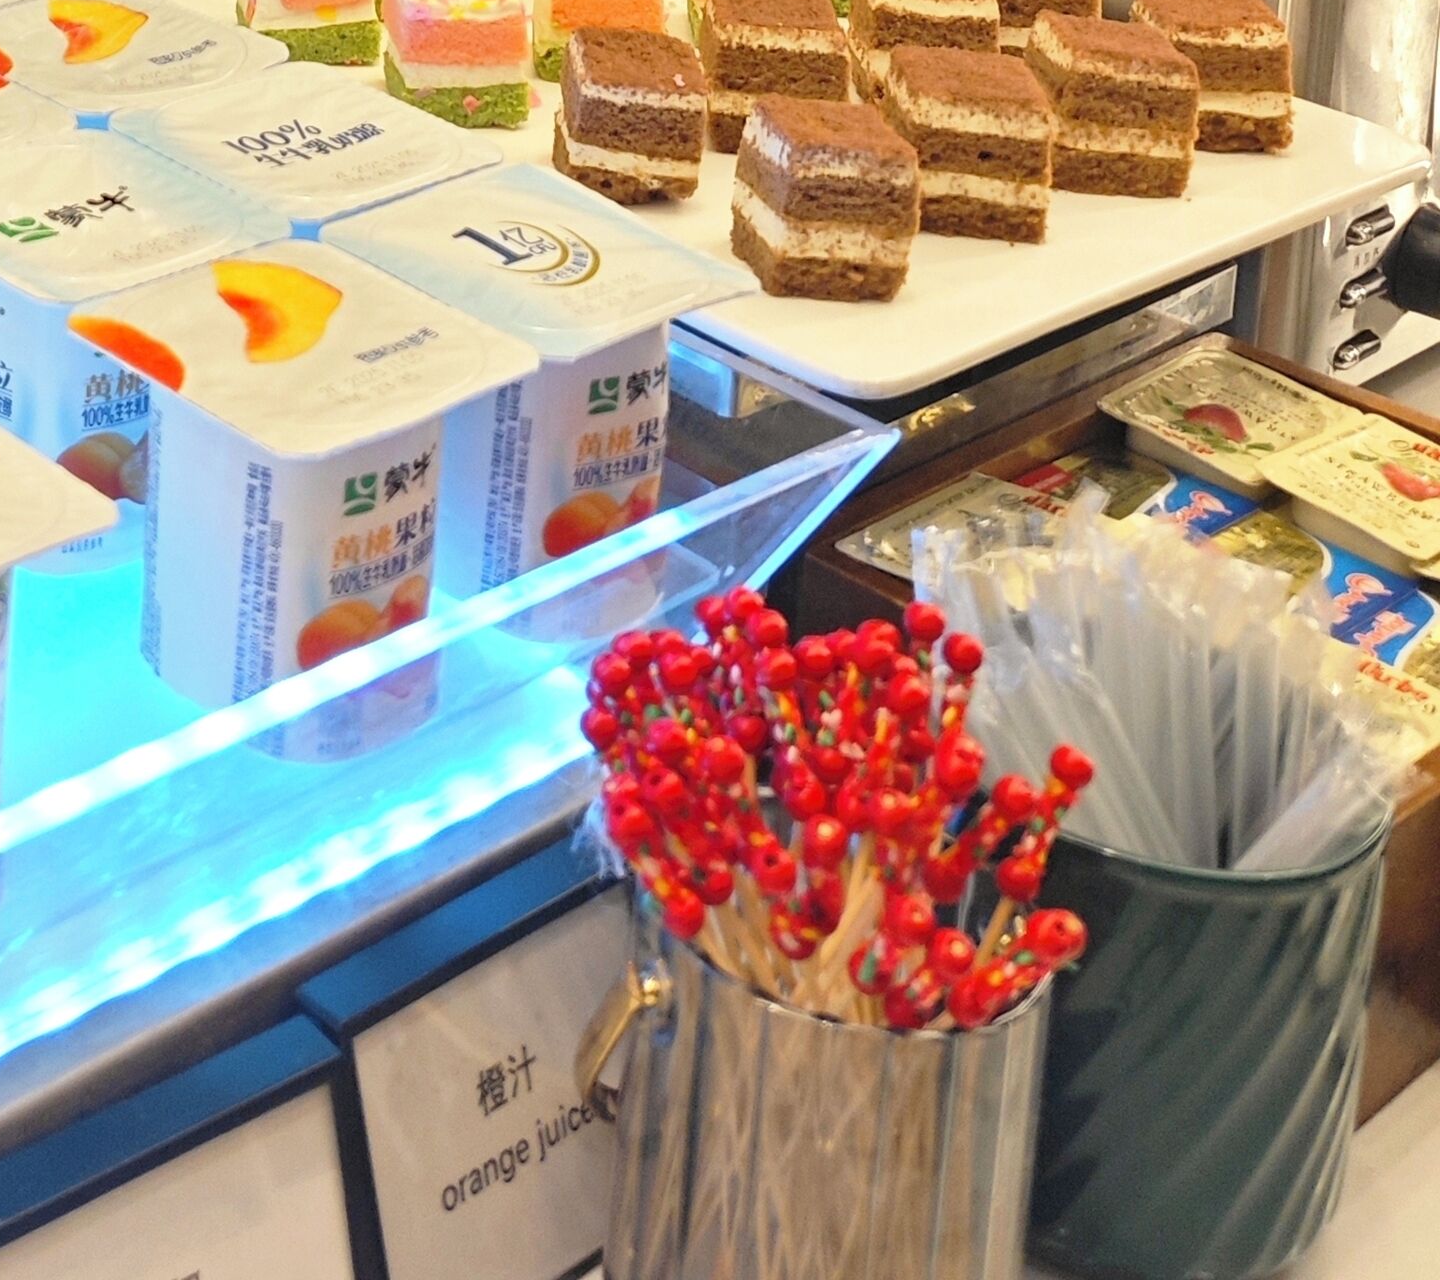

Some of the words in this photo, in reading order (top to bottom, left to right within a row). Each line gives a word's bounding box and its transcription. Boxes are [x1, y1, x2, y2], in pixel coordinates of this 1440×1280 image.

[221, 119, 321, 154] 100%
[44, 191, 135, 228] 蒙牛
[384, 452, 432, 503] 蒙牛
[476, 1044, 536, 1116] 橙汁
[442, 1138, 530, 1211] orange
[536, 1105, 596, 1161] juice
